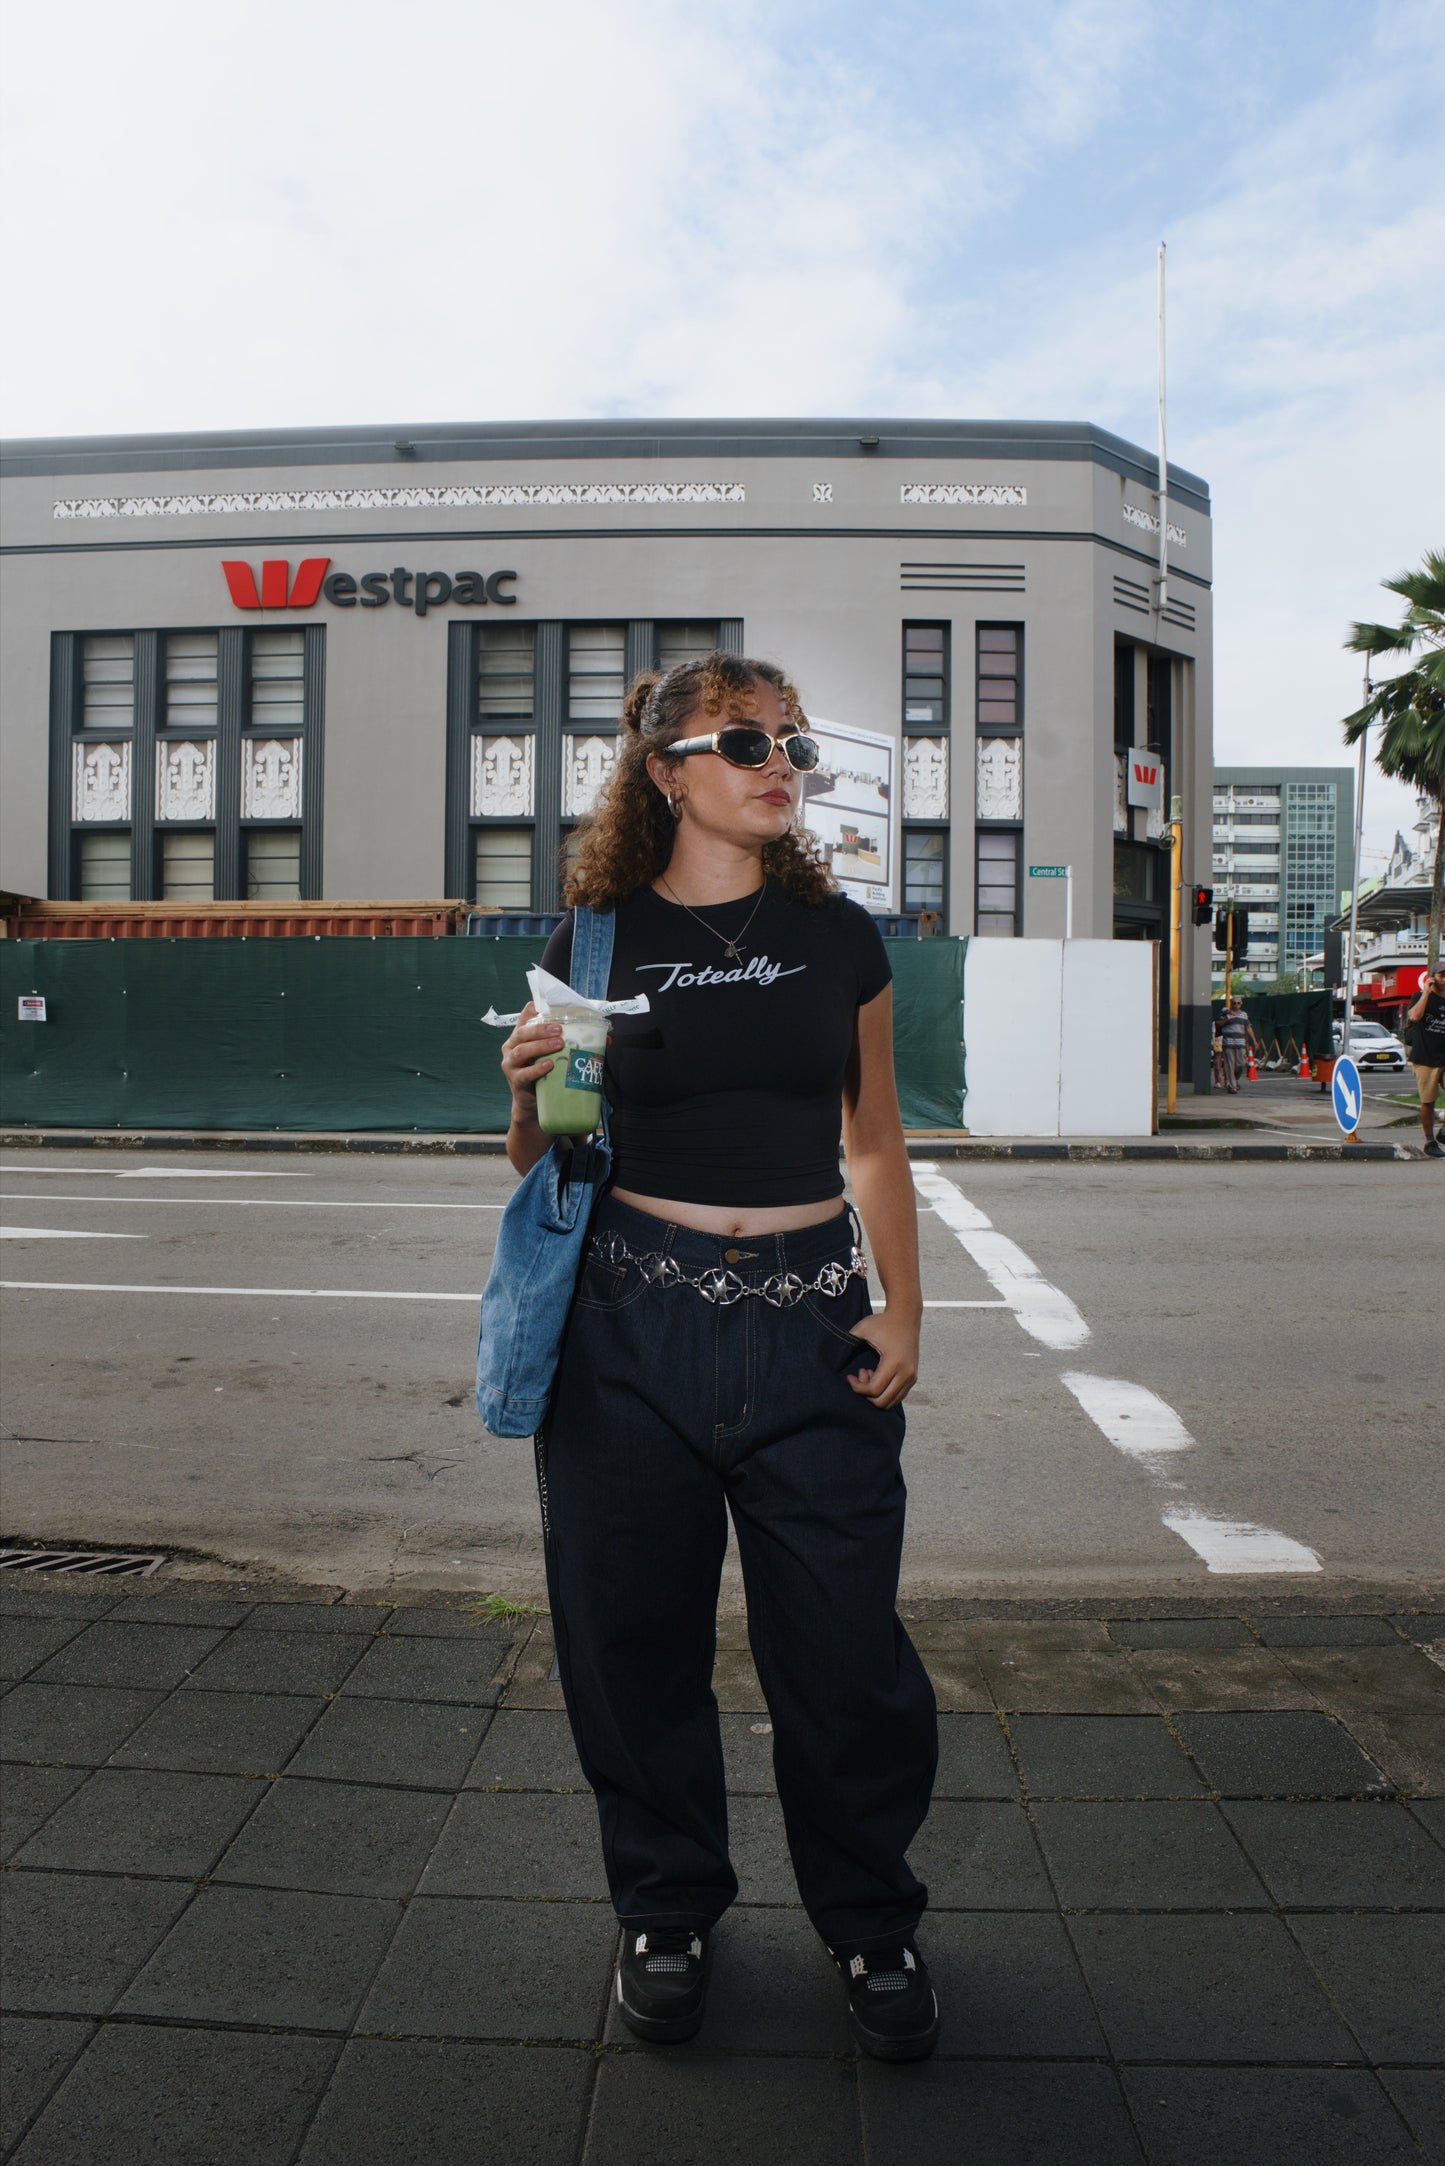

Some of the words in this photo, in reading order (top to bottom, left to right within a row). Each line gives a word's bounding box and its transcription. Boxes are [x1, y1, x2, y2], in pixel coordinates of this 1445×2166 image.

[221, 558, 517, 616] Westpac
[1032, 867, 1057, 876] Central
[1057, 867, 1065, 876] St
[635, 955, 807, 993] Toteally
